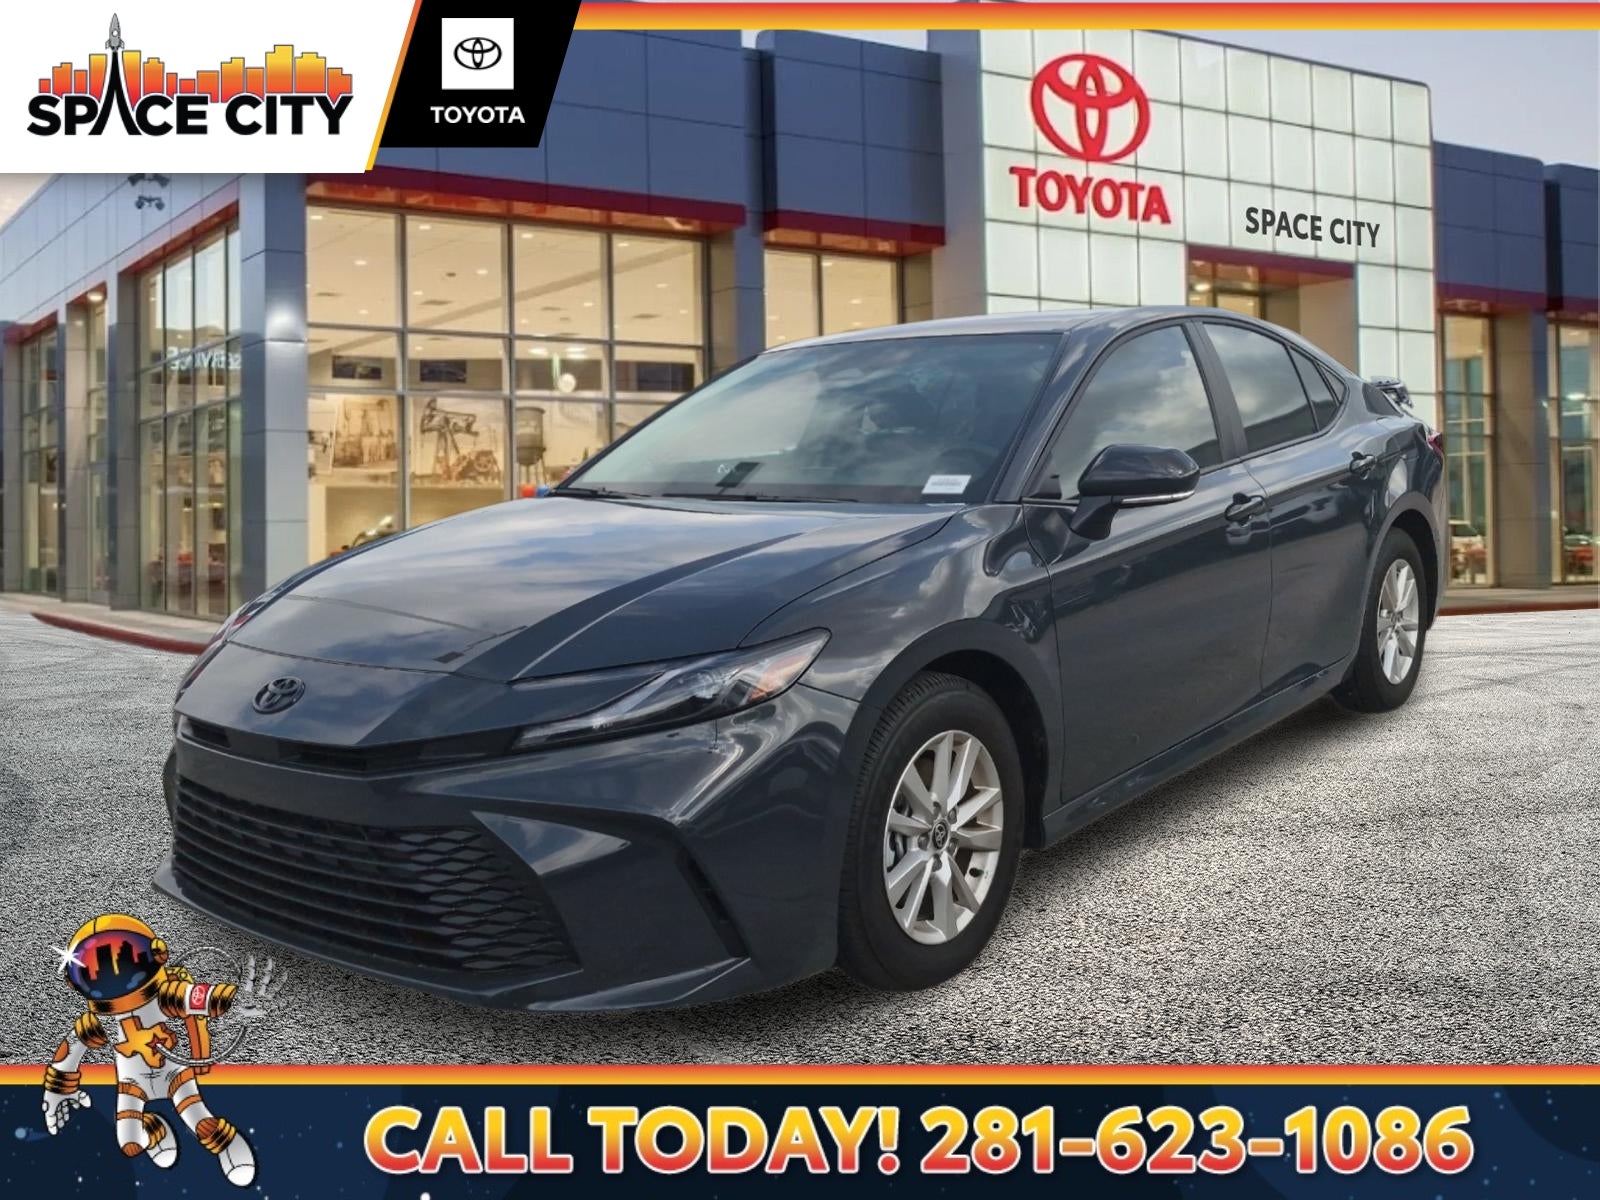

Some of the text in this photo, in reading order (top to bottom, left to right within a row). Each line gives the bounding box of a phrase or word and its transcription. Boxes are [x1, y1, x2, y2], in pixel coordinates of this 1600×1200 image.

[1010, 166, 1171, 224] TOYOTA
[1245, 206, 1380, 248] SPACE CITY
